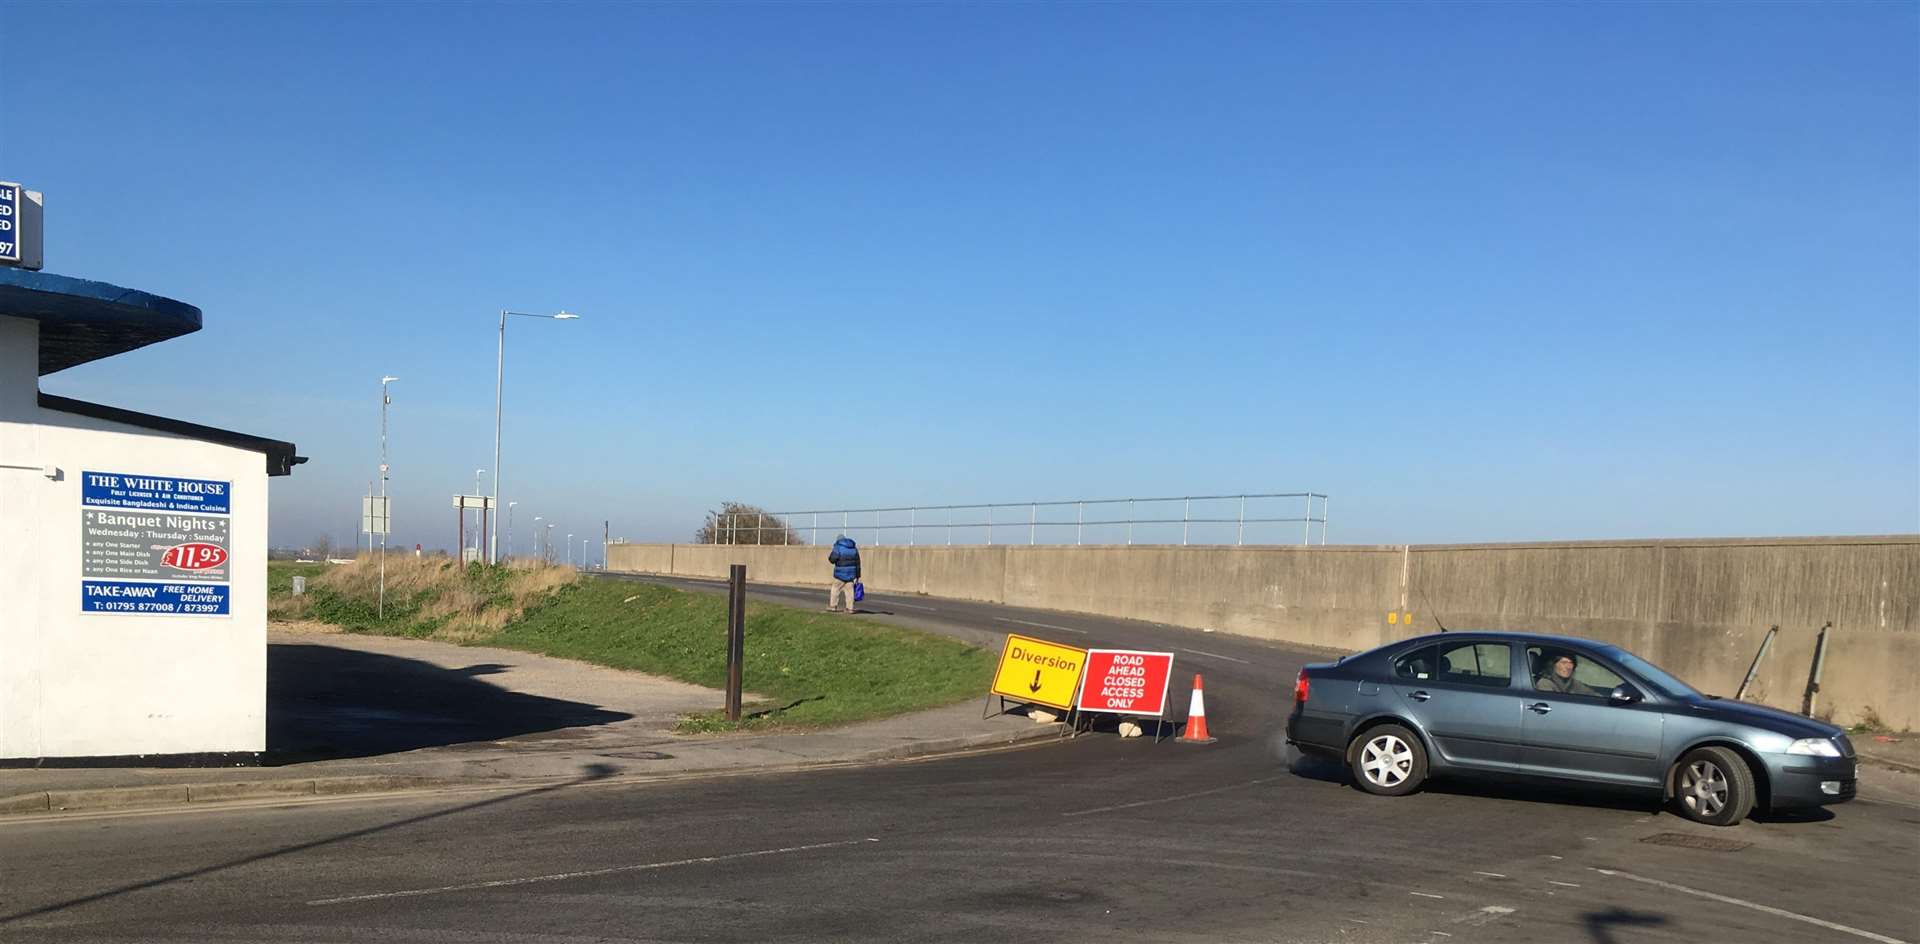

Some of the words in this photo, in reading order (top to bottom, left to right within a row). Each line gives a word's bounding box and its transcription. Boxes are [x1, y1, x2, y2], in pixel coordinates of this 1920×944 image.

[88, 475, 119, 487] THE
[124, 478, 174, 491] WHITE
[178, 481, 224, 495] HOUSE
[86, 497, 121, 506] Exquisite
[122, 499, 167, 508] Bangladeshi
[176, 502, 199, 510] Indian
[200, 504, 226, 512] Cuisine
[98, 512, 161, 527] Banquet
[166, 516, 216, 531] Nights
[88, 527, 140, 538] Wednesday
[146, 530, 187, 541] Thursday
[193, 533, 225, 543] Sunday
[85, 584, 158, 598] TAKE-AWAY
[162, 585, 185, 593] FREE
[186, 586, 215, 594] HOME
[180, 594, 224, 603] DELIVERY
[93, 601, 104, 610] T:
[105, 602, 135, 611] 01795
[138, 602, 174, 611] 877008
[176, 603, 181, 612] /
[184, 603, 219, 613] 873997
[1011, 646, 1076, 671] Diversion
[1113, 655, 1144, 666] ROAD
[1108, 665, 1145, 676] AHEAD
[1103, 676, 1145, 687] CLOSED
[1100, 687, 1144, 698] ACCESS
[1107, 697, 1134, 708] ONLY
